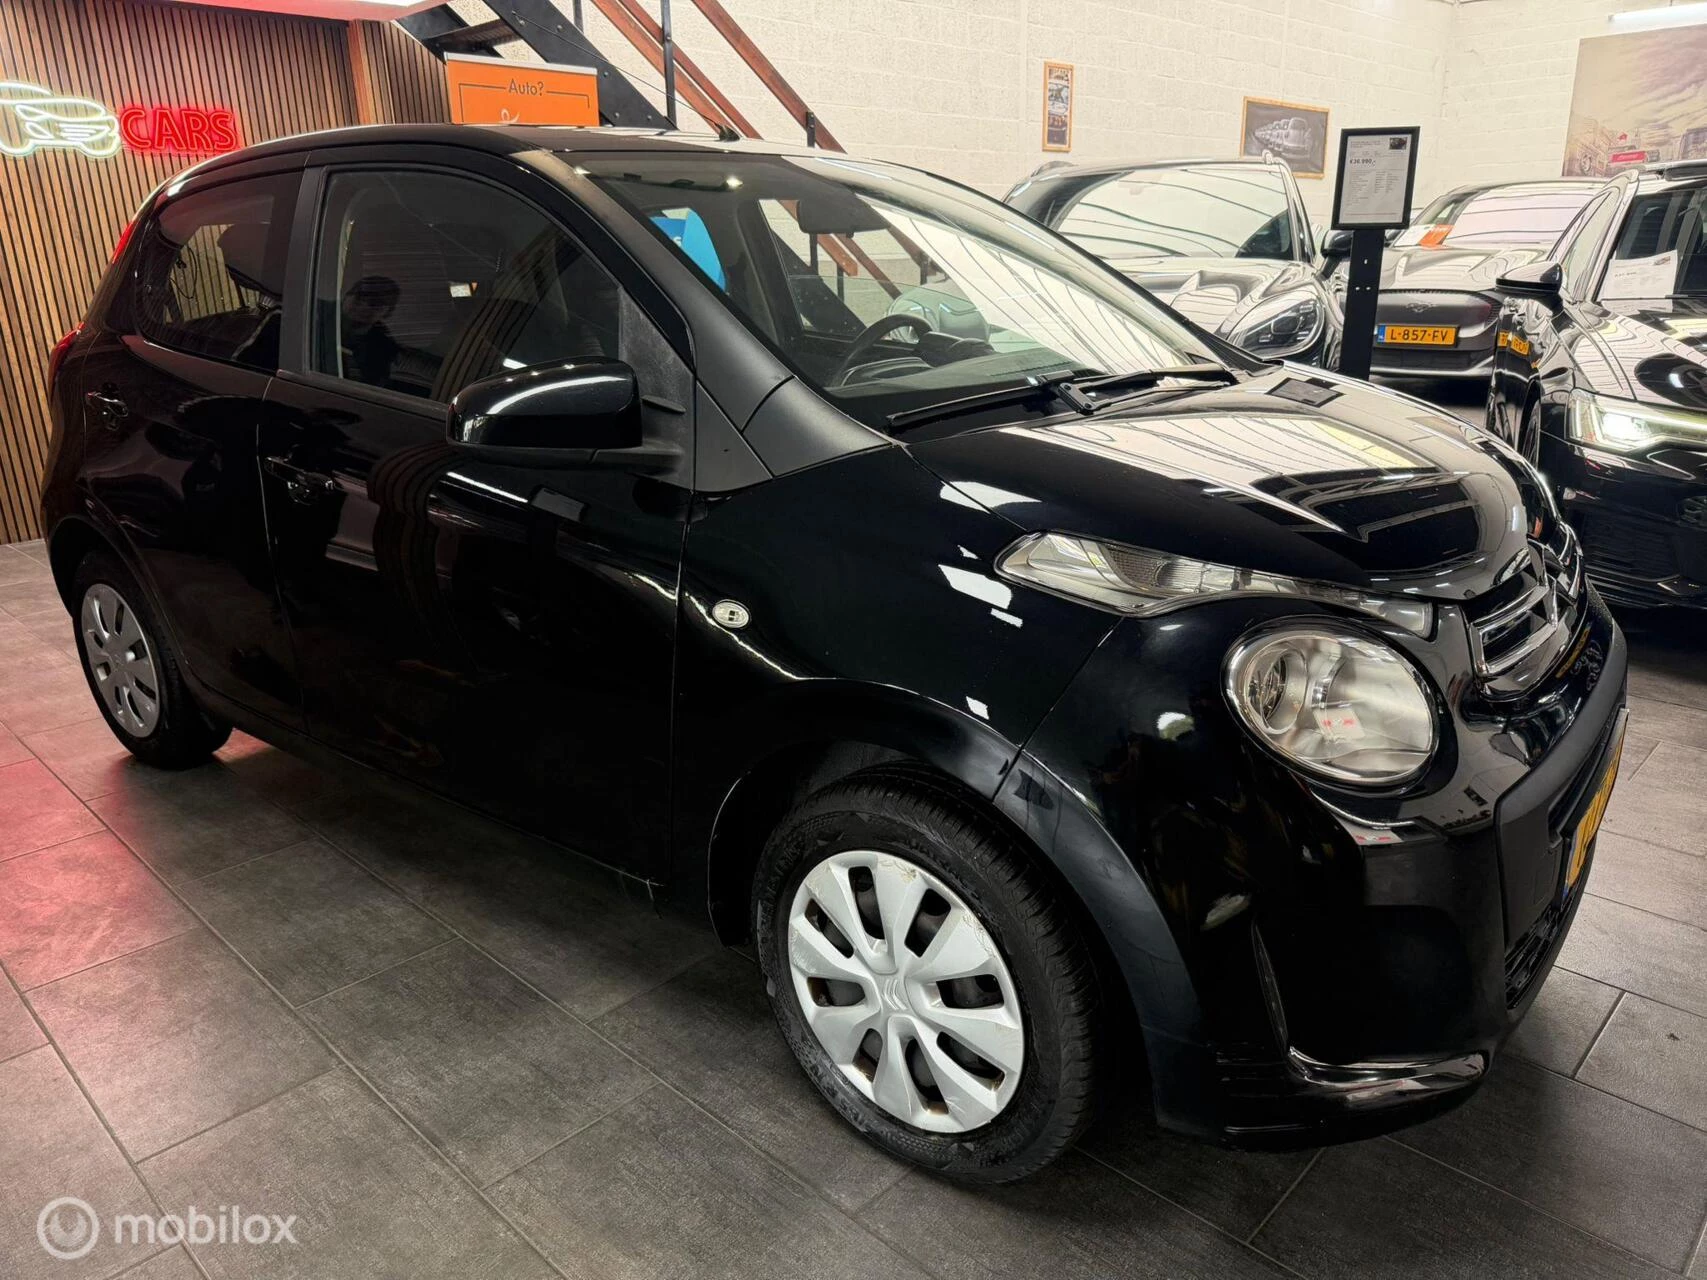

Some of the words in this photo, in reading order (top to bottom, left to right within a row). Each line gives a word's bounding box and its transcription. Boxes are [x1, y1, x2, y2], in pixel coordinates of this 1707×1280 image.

[508, 79, 544, 97] Auto?
[120, 108, 236, 151] CARS
[1390, 328, 1448, 342] L-857-FV
